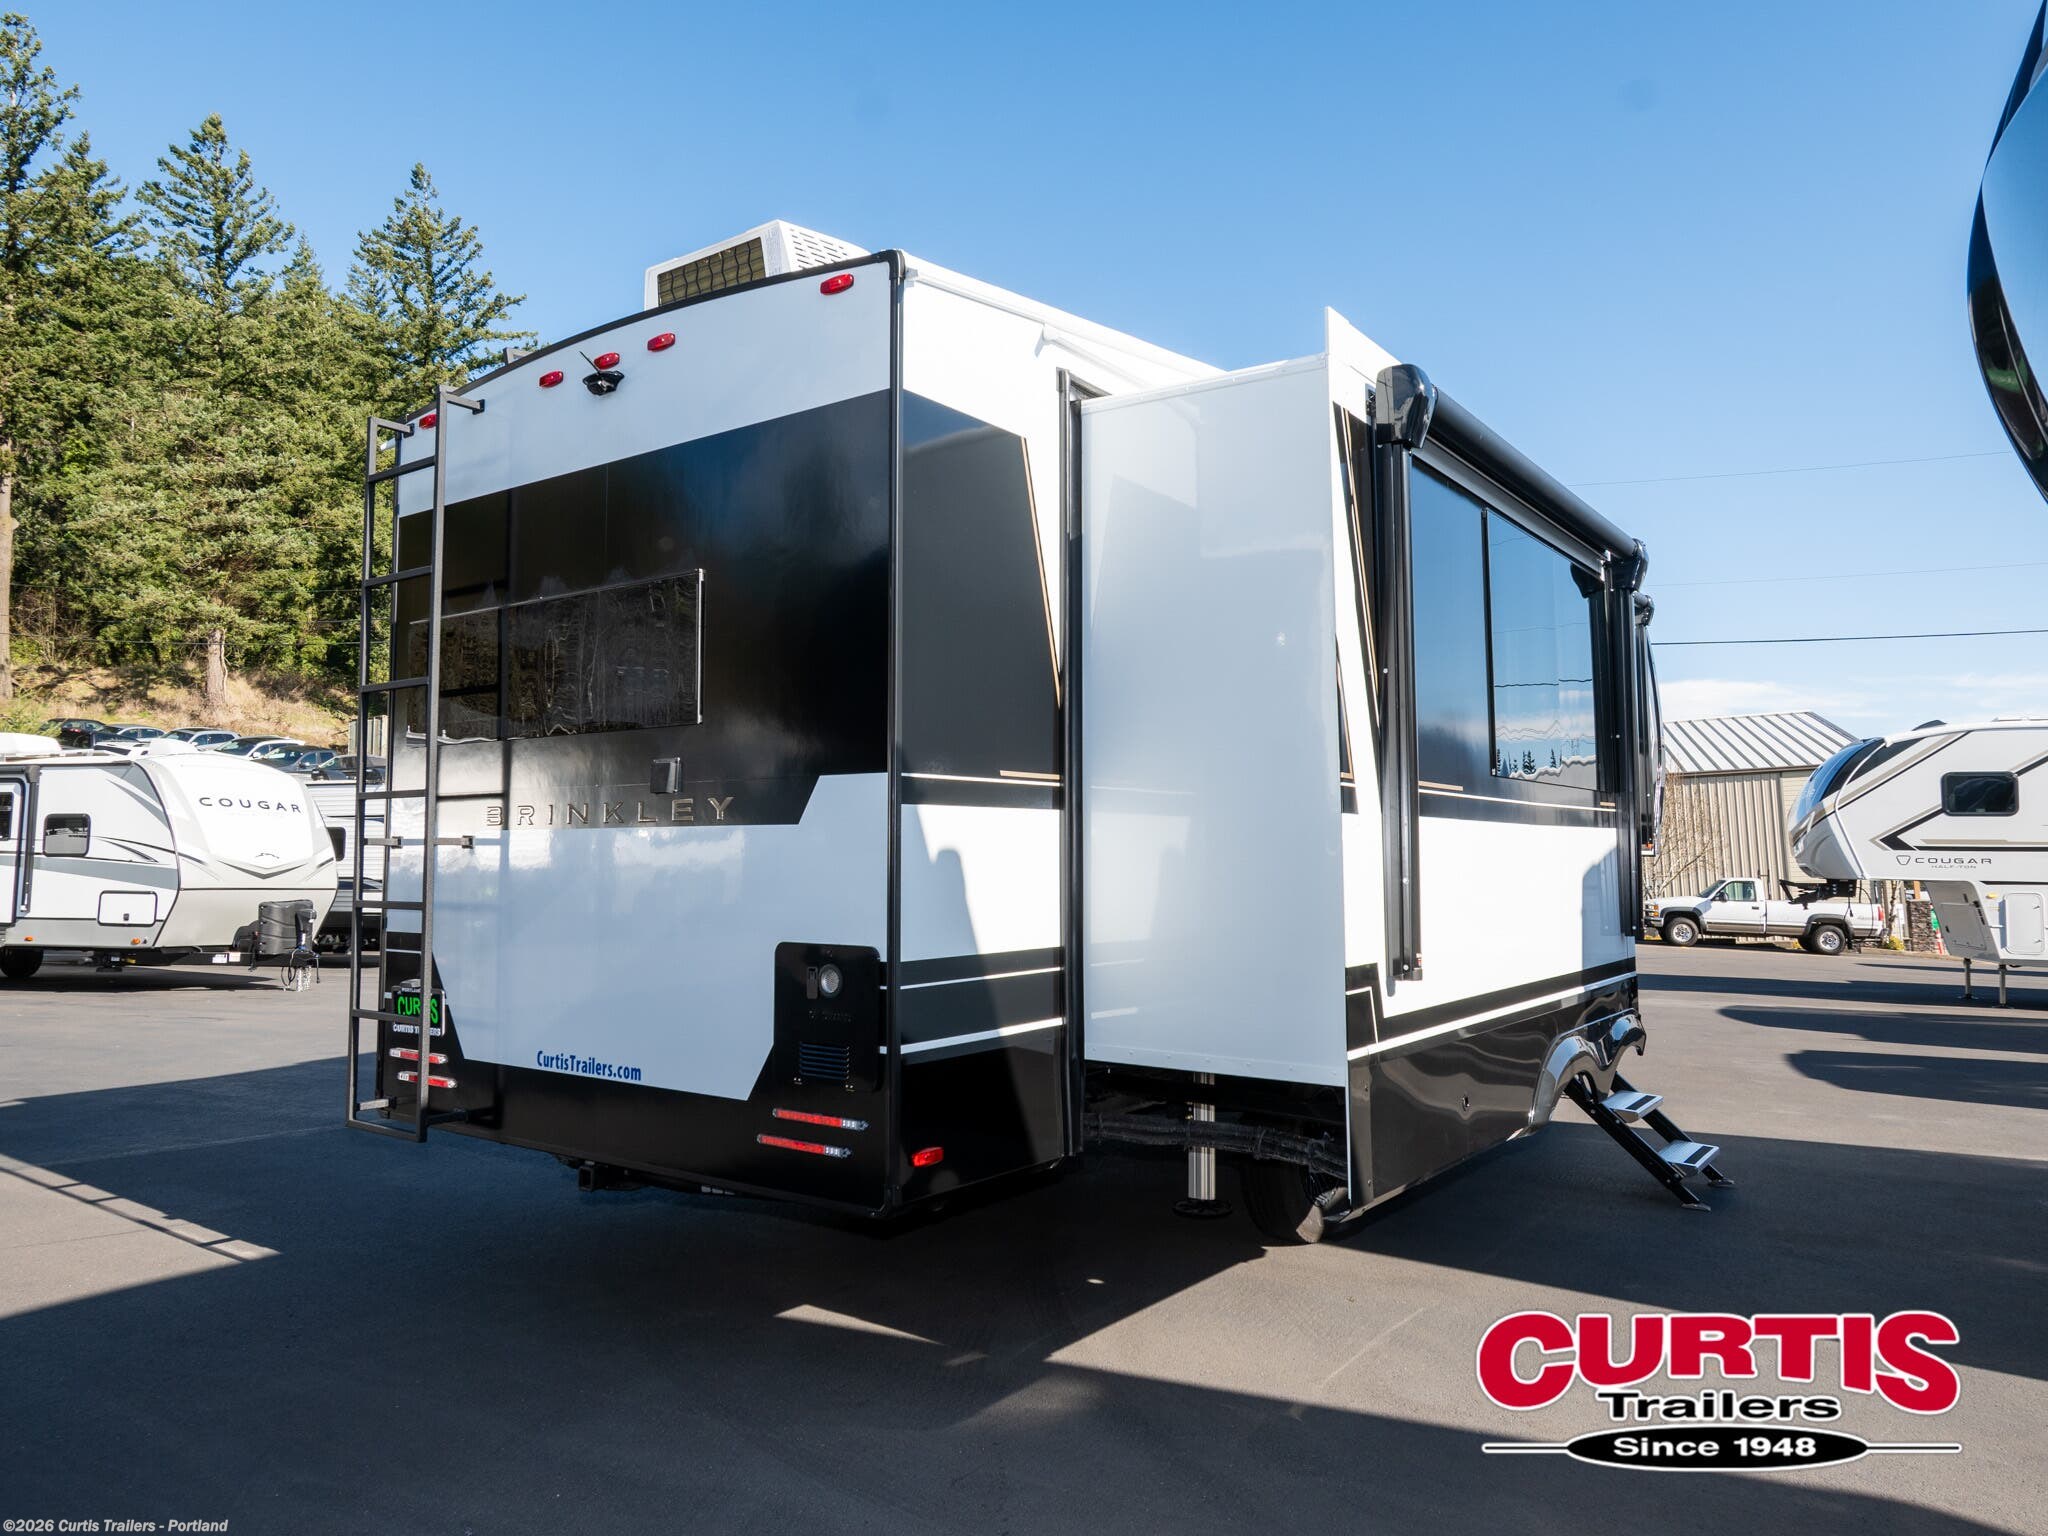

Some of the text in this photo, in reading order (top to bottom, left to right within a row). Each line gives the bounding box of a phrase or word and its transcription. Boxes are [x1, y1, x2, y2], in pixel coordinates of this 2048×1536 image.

[199, 796, 302, 814] COUGAR
[485, 796, 735, 826] BRINKLEY
[1914, 857, 1993, 865] COUGAR
[397, 995, 439, 1025] CURS
[536, 1050, 642, 1082] CurtisTrailers.com
